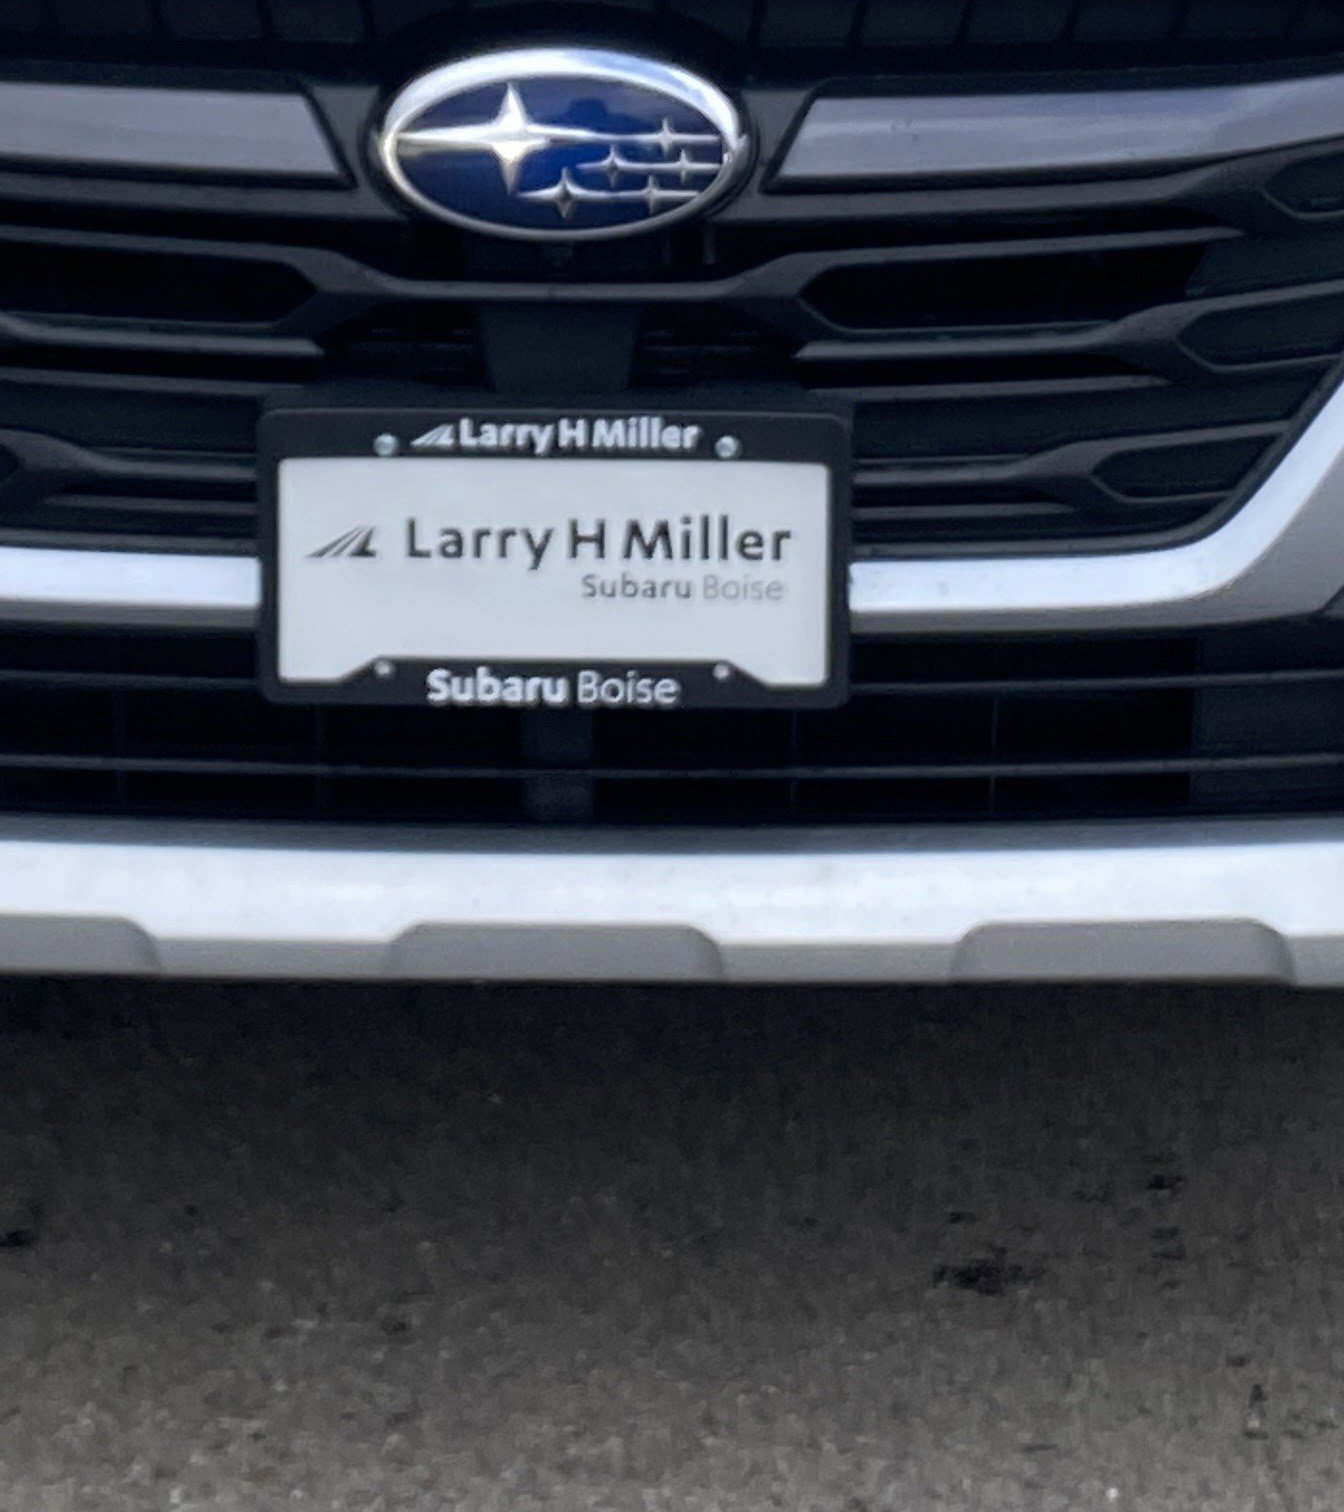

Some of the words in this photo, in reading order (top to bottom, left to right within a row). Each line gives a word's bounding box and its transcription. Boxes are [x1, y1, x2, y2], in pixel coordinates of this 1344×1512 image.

[458, 418, 554, 455] Larry
[558, 419, 587, 449] H
[592, 417, 701, 451] Miller
[406, 518, 553, 570] Larry
[568, 518, 606, 560] H
[623, 515, 792, 562] Miller
[581, 573, 692, 599] Subaru
[702, 574, 784, 601] Boise
[426, 666, 568, 705] Subaru
[577, 669, 680, 706] Boise
